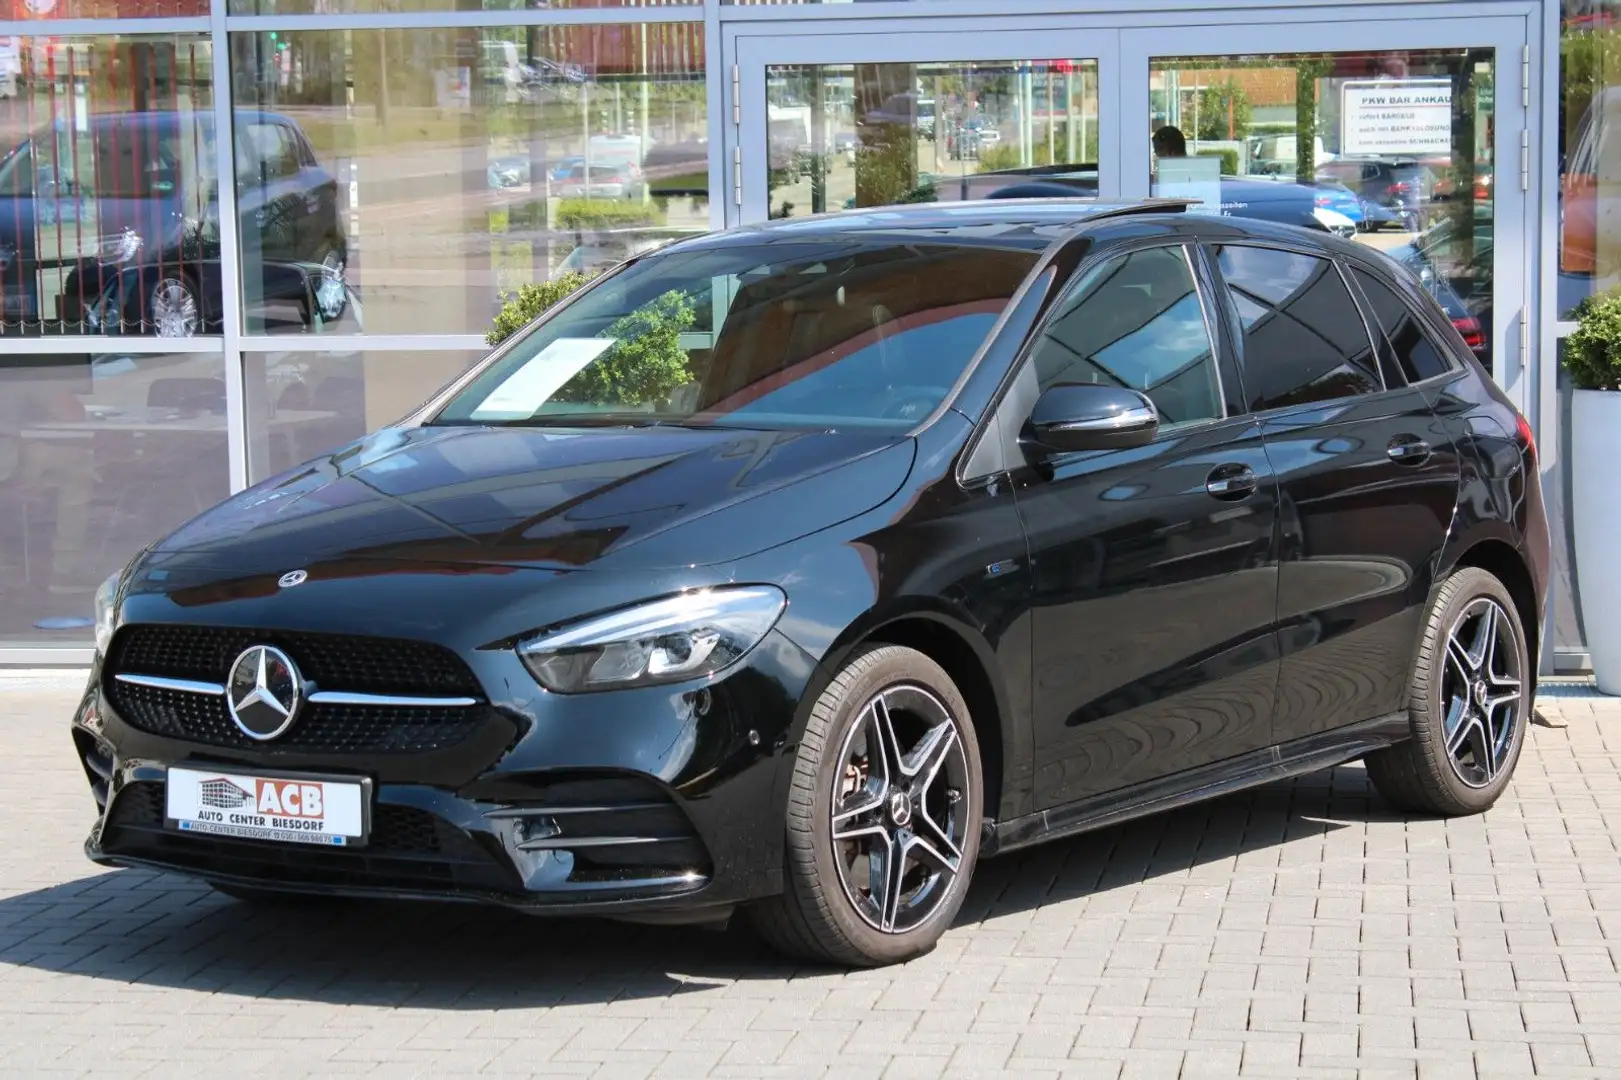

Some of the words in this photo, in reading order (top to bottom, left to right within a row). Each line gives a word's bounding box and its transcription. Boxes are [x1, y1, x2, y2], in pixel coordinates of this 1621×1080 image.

[1362, 96, 1386, 105] PKW
[1389, 96, 1411, 104] BAR
[258, 781, 323, 817] ACB
[190, 822, 207, 831] AUTO
[209, 825, 236, 834] CENTER
[237, 828, 272, 838] BIESDORF
[198, 810, 223, 822] AUTO
[229, 813, 266, 827] CENTER
[272, 818, 325, 832] BIESDORF
